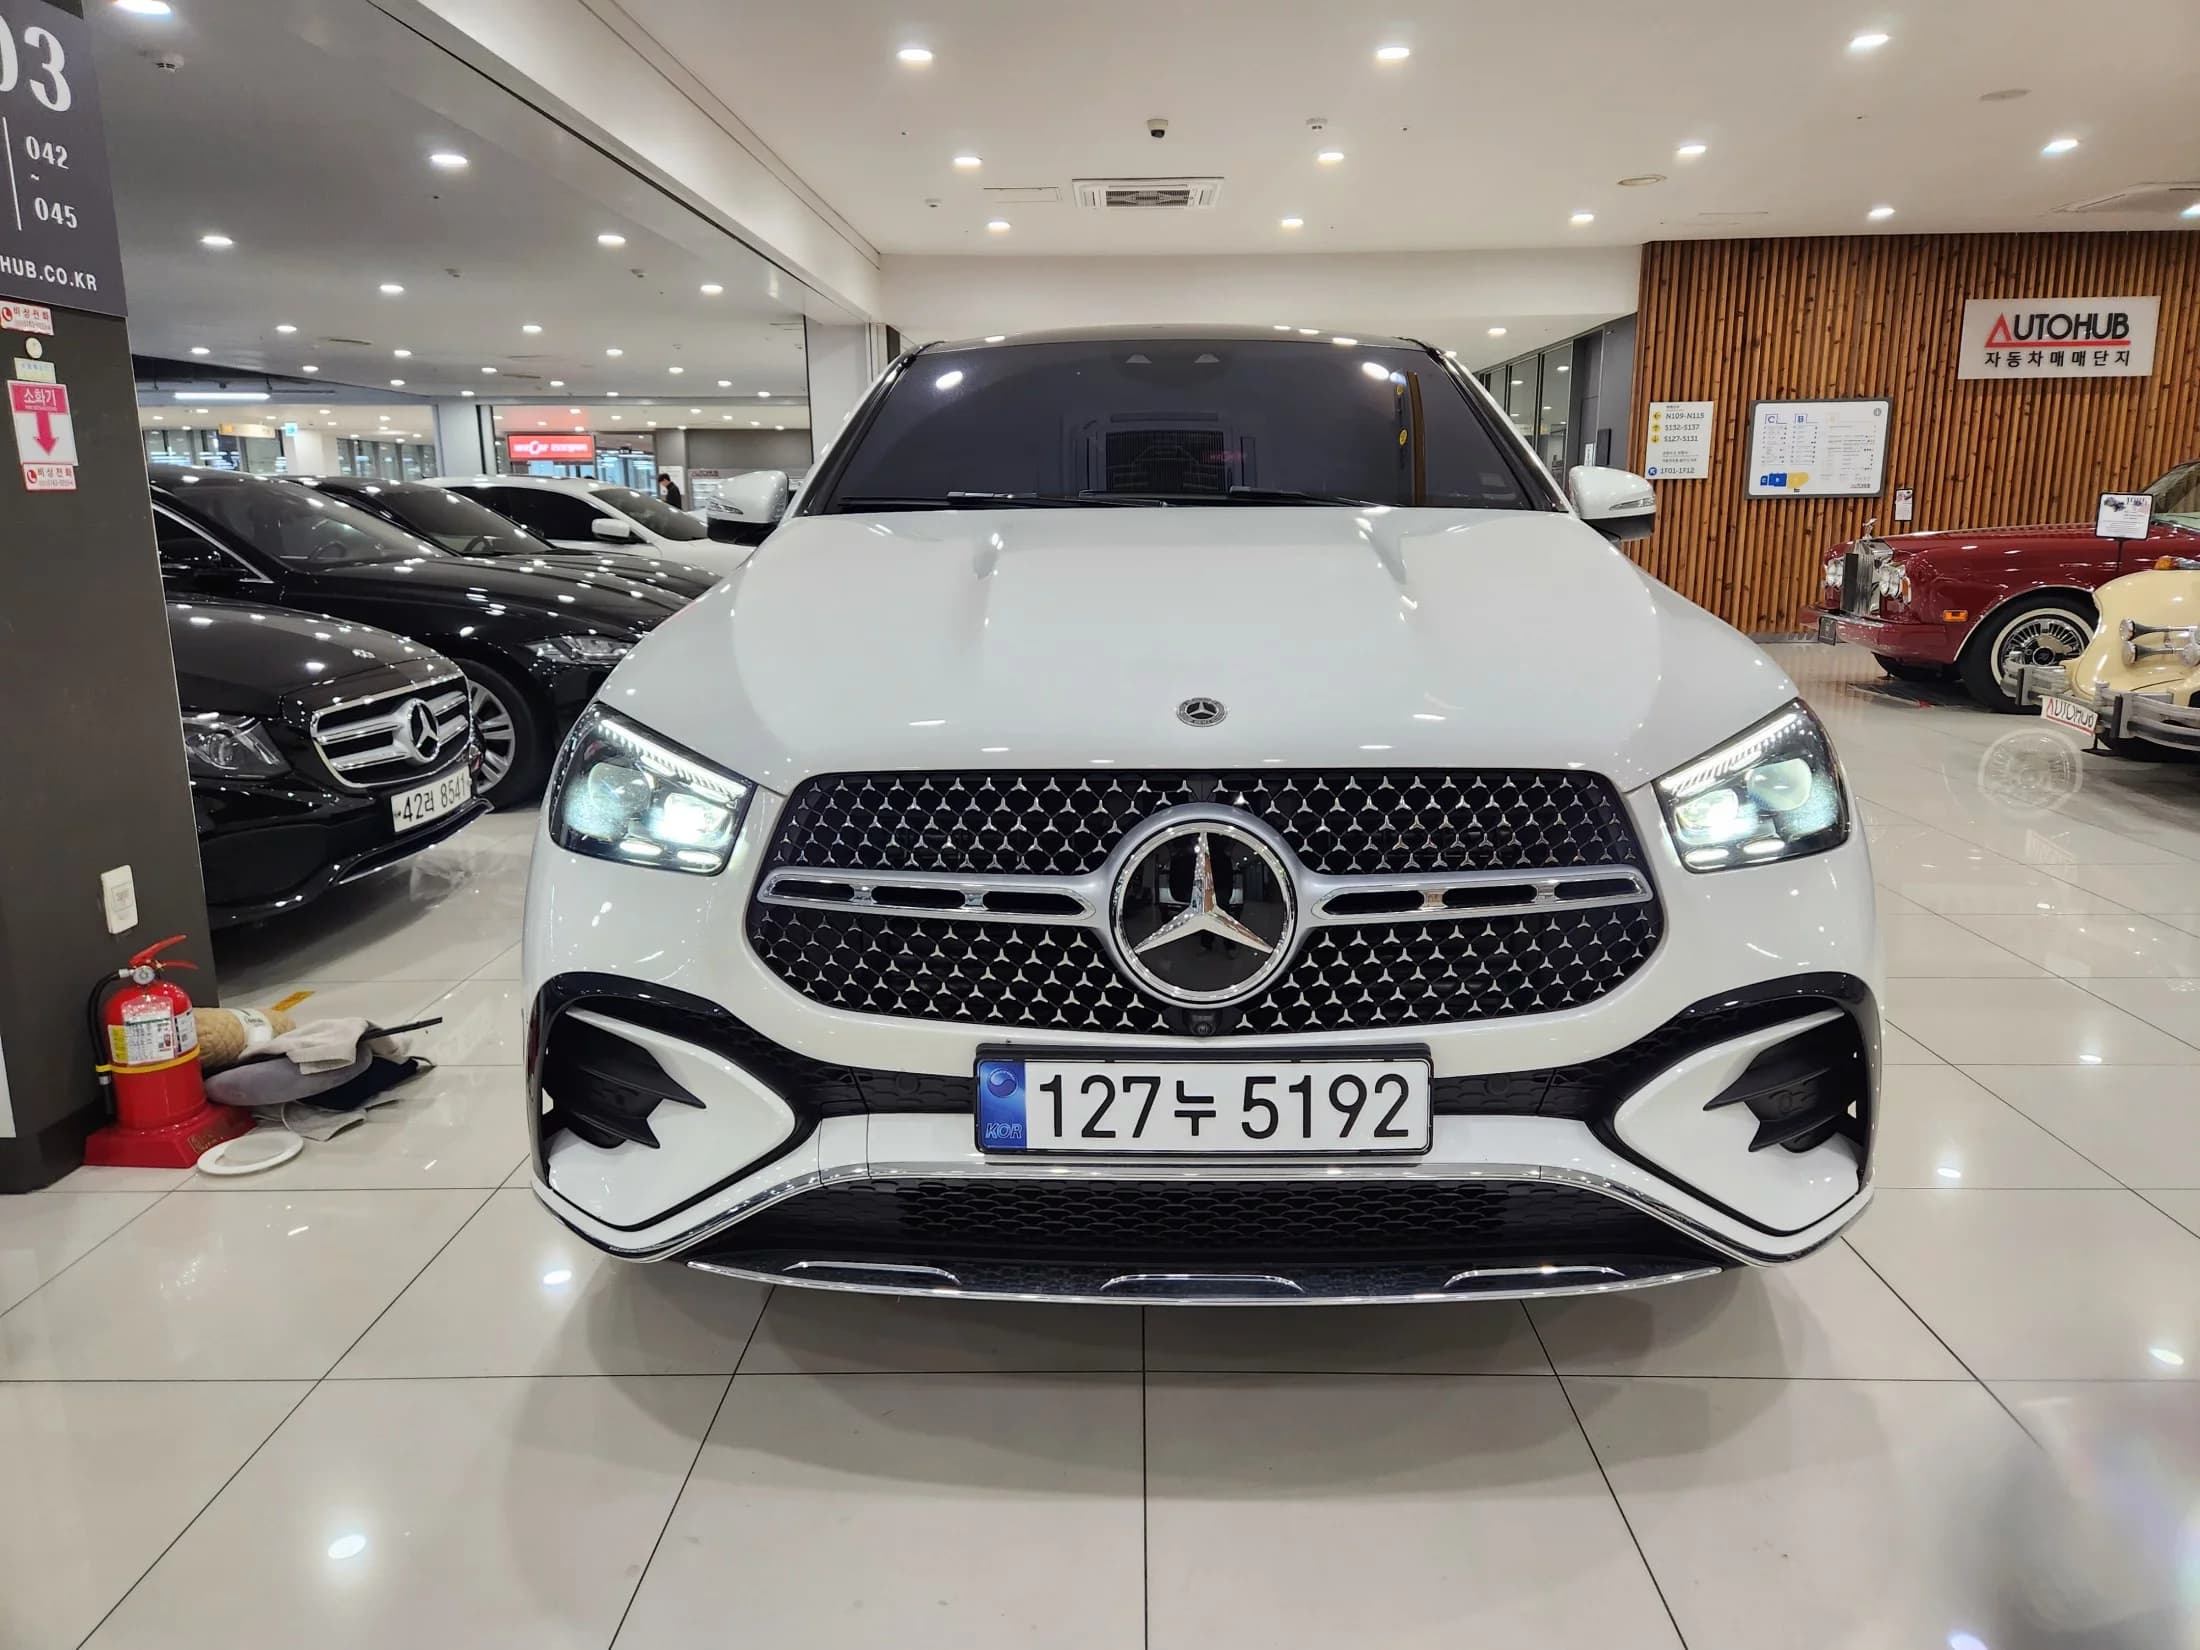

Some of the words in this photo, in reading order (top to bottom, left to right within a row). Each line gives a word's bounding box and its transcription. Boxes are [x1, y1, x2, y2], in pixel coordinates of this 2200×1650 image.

[25, 136, 70, 170] 042
[34, 197, 78, 229] 045
[0, 256, 97, 291] HUB.CO.KR
[1984, 312, 2131, 347] AUTOHUB
[1985, 350, 2131, 367] 자동차매매단지
[24, 388, 57, 406] 소화기
[1039, 1074, 1217, 1139] 127누
[1240, 1073, 1409, 1139] 5192
[985, 1123, 1022, 1140] KOR
